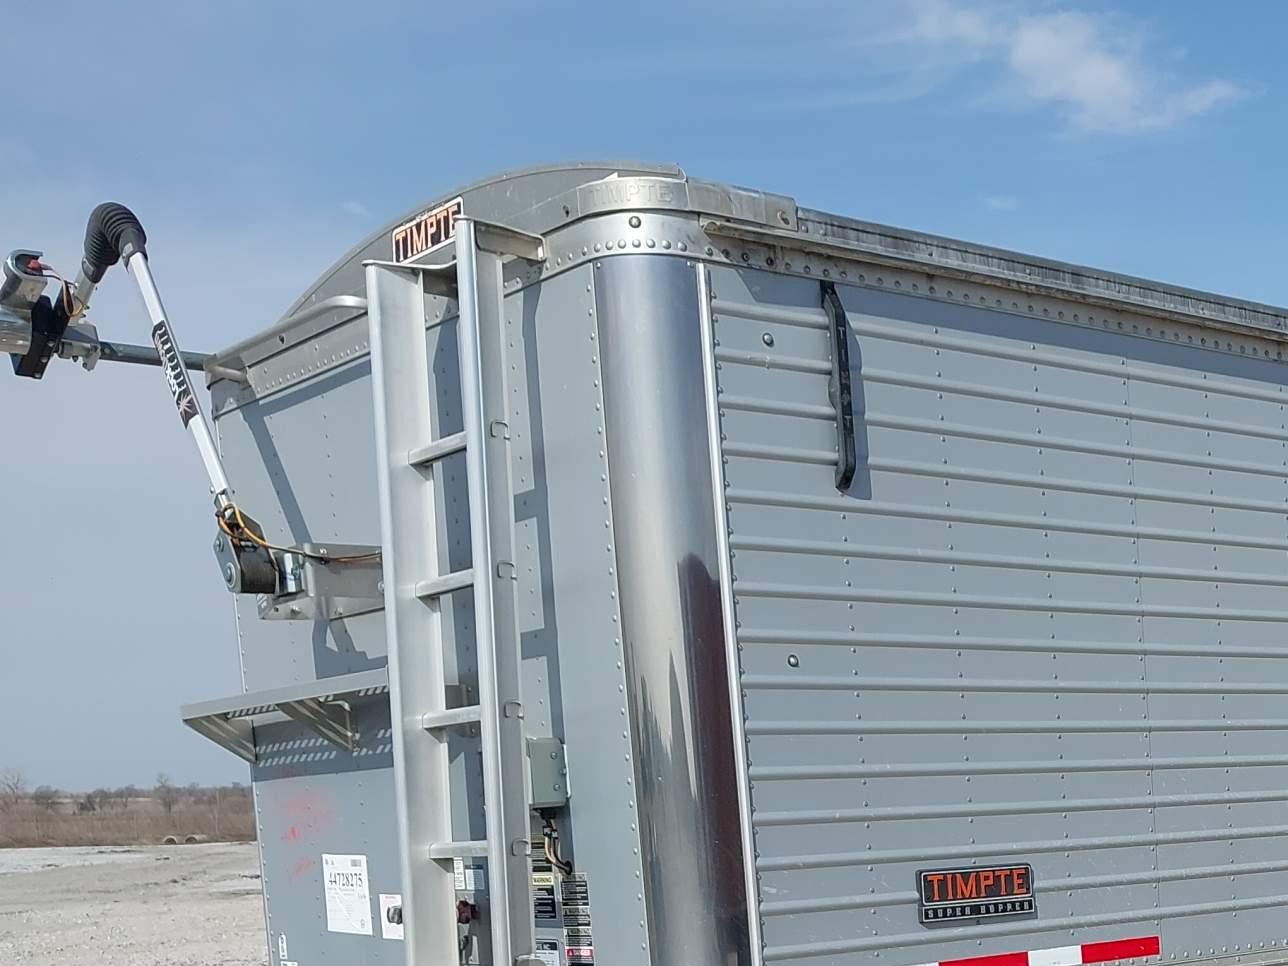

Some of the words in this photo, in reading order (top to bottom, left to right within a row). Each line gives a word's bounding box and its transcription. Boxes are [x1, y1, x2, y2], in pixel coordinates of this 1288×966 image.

[395, 203, 458, 262] TIMPTE
[328, 872, 363, 887] 44728275
[927, 869, 1027, 900] TIMPTE
[927, 906, 971, 919] SUPER
[980, 902, 1029, 914] HOPPER
